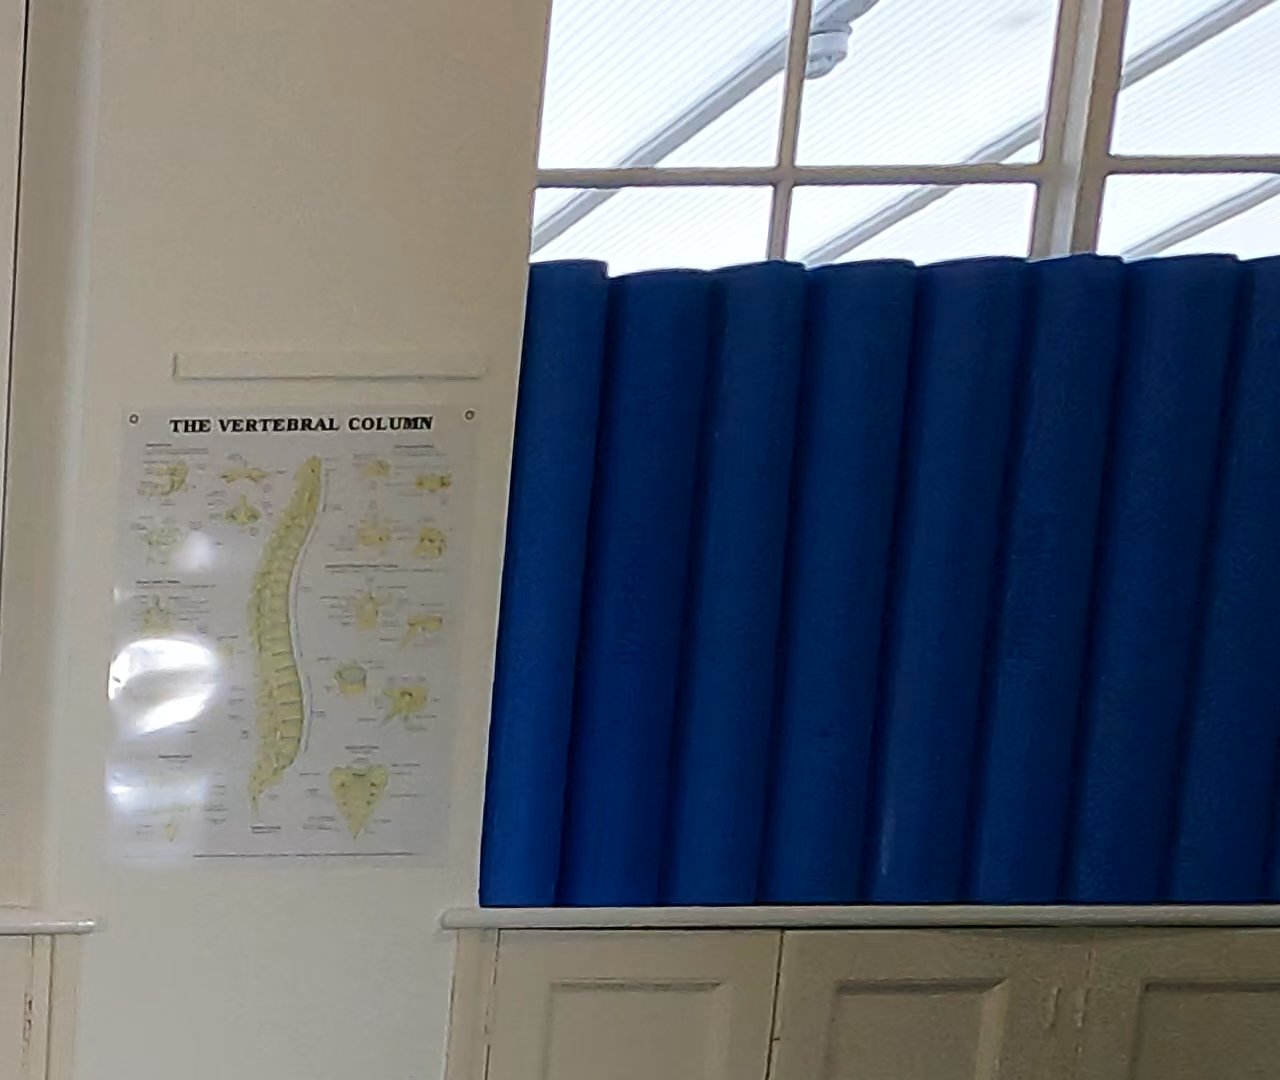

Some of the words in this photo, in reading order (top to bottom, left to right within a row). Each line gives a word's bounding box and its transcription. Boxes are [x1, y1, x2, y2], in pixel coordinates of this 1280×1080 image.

[169, 419, 211, 433] THE
[218, 417, 340, 432] VERTEBRAL
[348, 416, 433, 431] COLUMN
